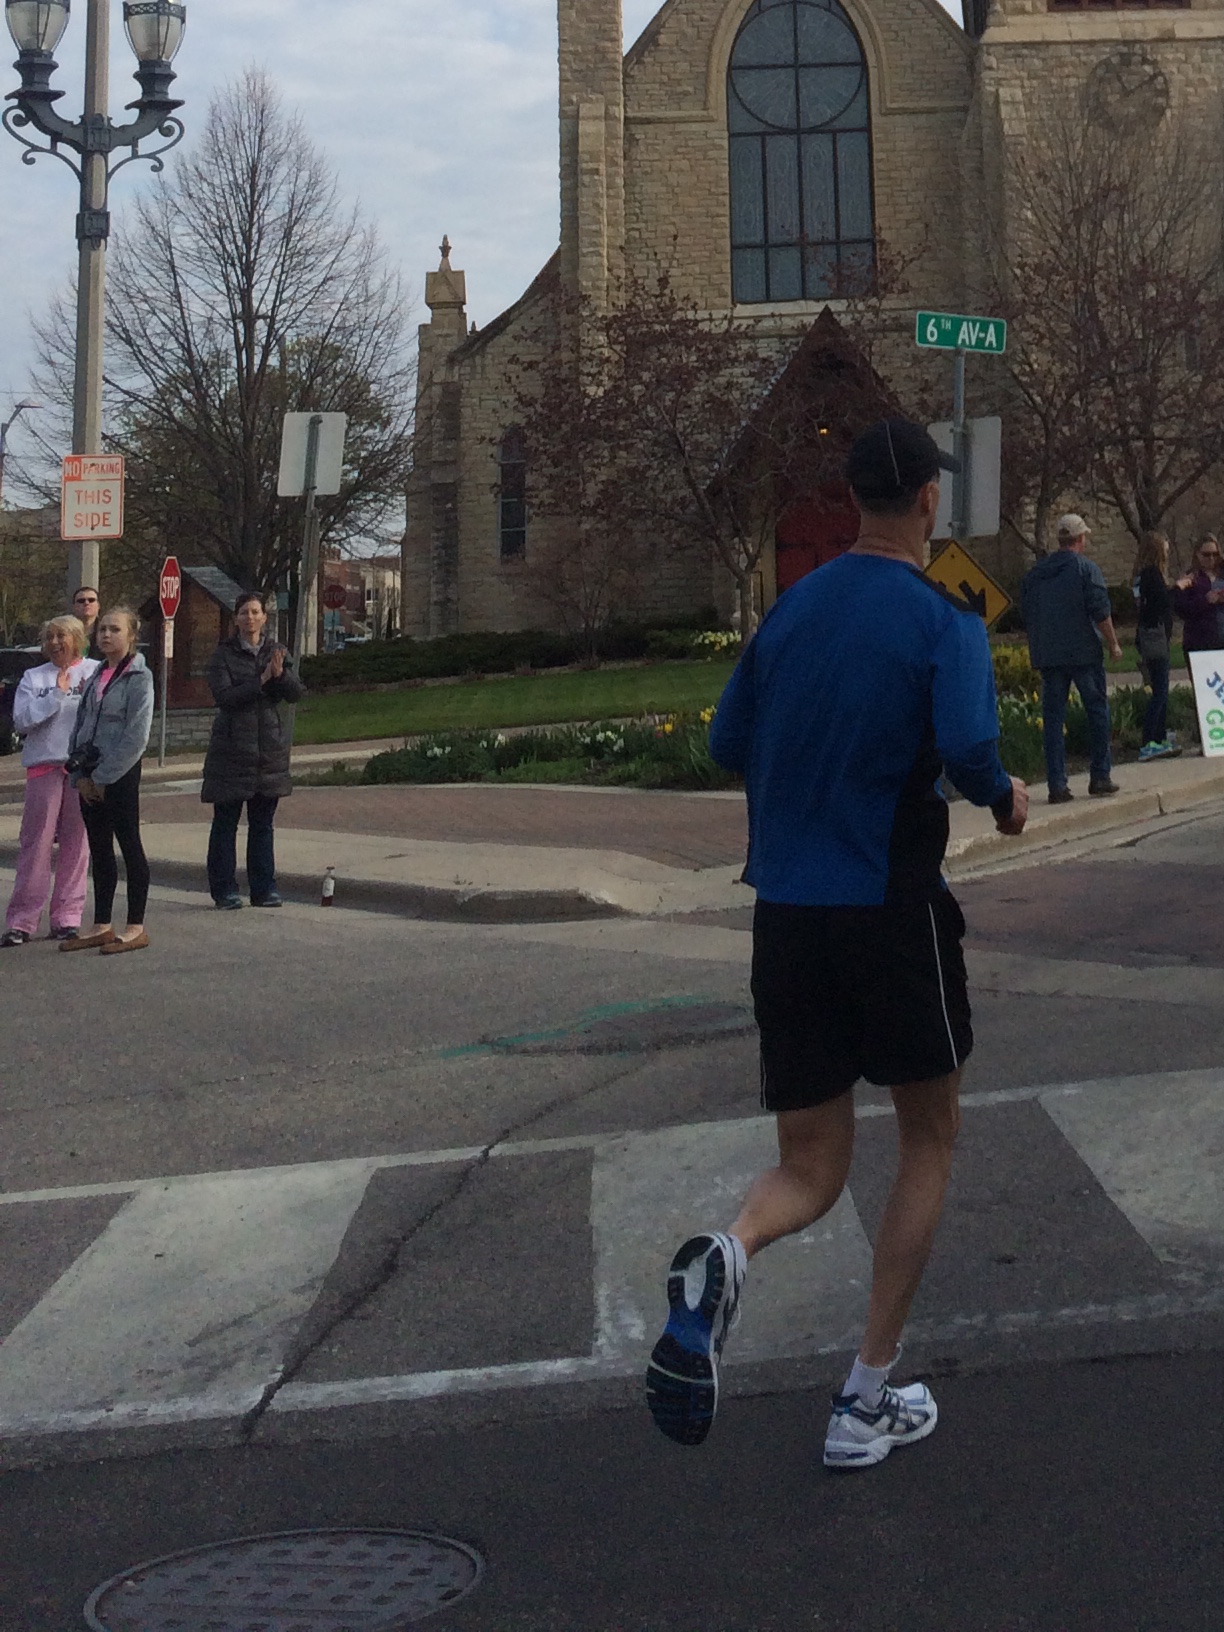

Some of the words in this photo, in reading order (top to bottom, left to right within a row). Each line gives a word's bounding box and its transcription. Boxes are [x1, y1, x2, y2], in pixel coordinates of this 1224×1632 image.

[957, 321, 997, 347] AV-A
[64, 461, 80, 477] NO
[82, 462, 120, 475] PARKING
[74, 489, 112, 505] THIS
[74, 512, 112, 528] SIDE
[161, 576, 180, 599] STOP
